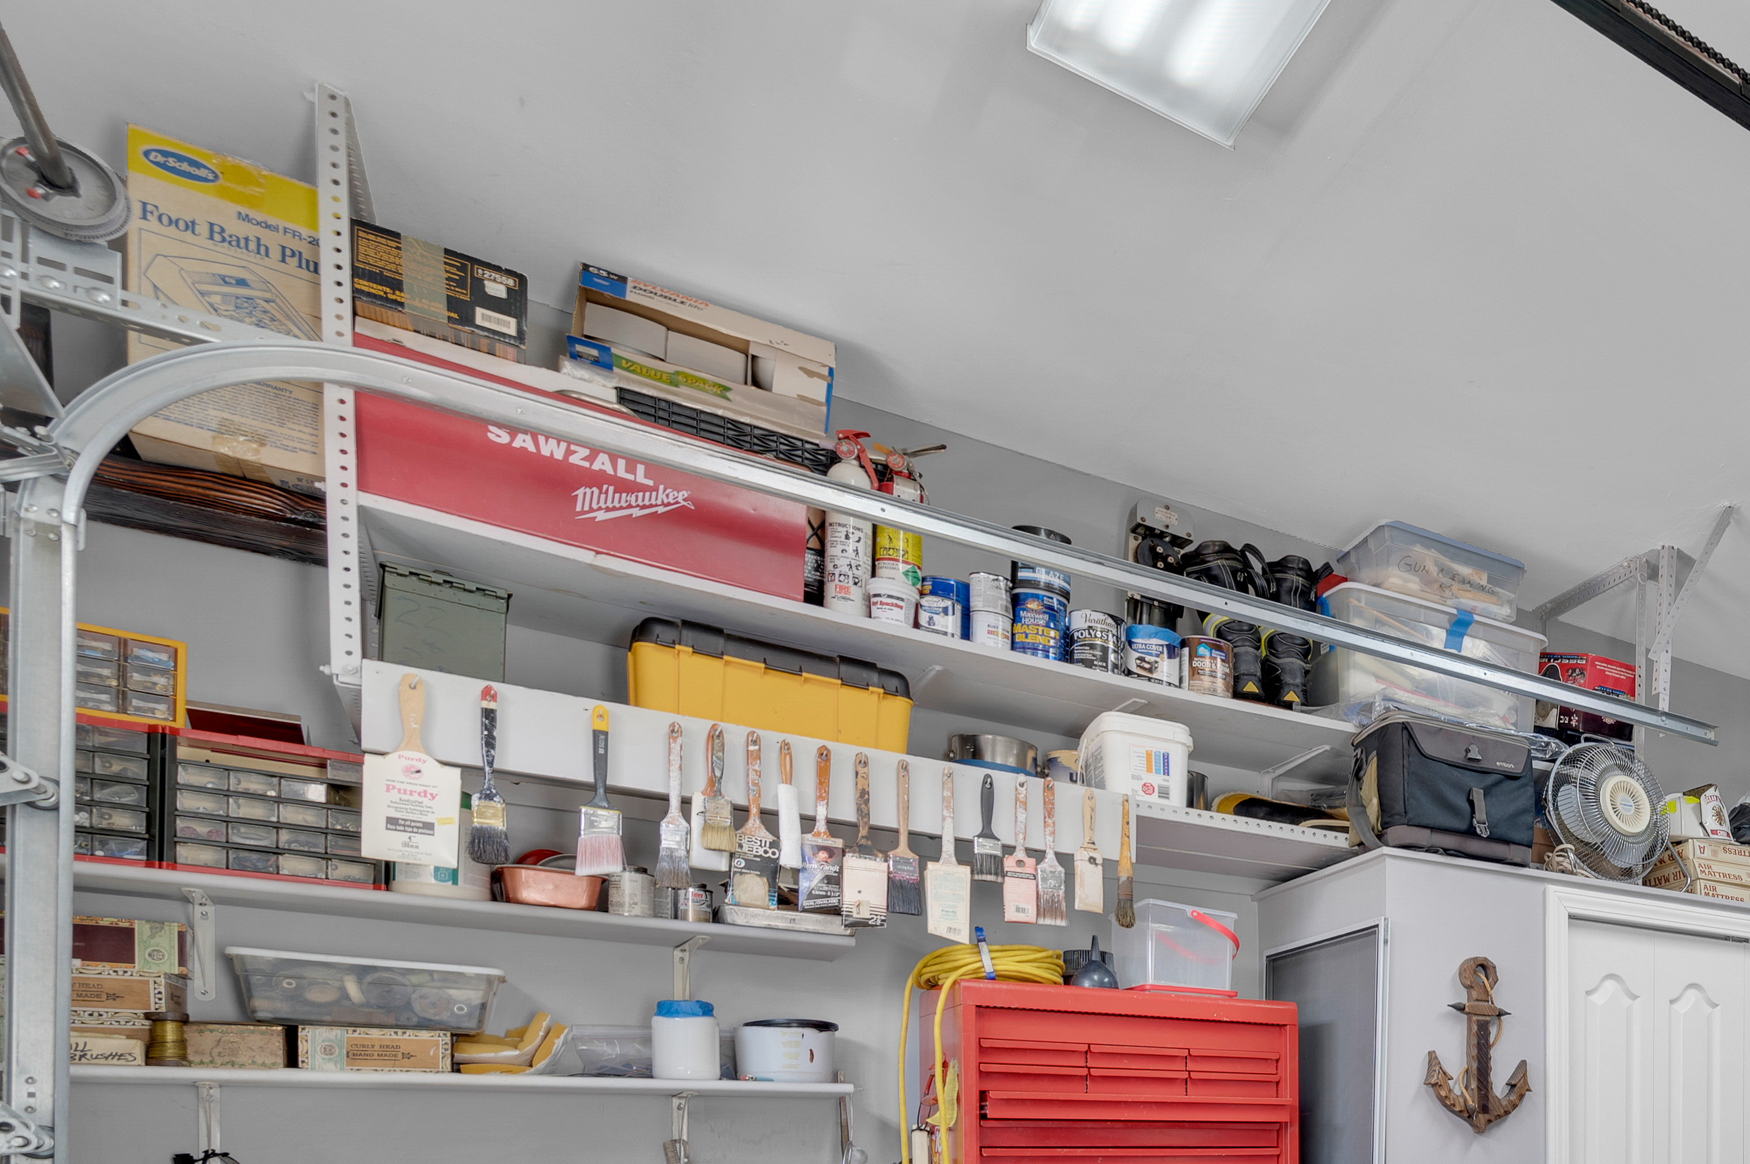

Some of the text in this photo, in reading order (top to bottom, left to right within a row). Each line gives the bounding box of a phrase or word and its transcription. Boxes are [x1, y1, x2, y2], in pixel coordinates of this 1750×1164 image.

[236, 211, 279, 234] Model
[138, 199, 201, 237] Foot
[206, 220, 272, 260] Bath
[277, 243, 321, 276] Plu
[630, 278, 710, 308] SYLVANIA
[631, 285, 688, 306] DOUBLE
[620, 358, 672, 383] VALUE
[487, 425, 655, 487] SAWZALL
[571, 484, 690, 512] Milwaukee
[1012, 623, 1060, 640] MASTER
[1015, 633, 1057, 647] BLEND
[398, 753, 428, 765] Purdy
[385, 783, 439, 801] Purdy
[1698, 862, 1713, 870] AIR
[1699, 867, 1743, 882] MATTRESS
[1703, 884, 1717, 893] AIR
